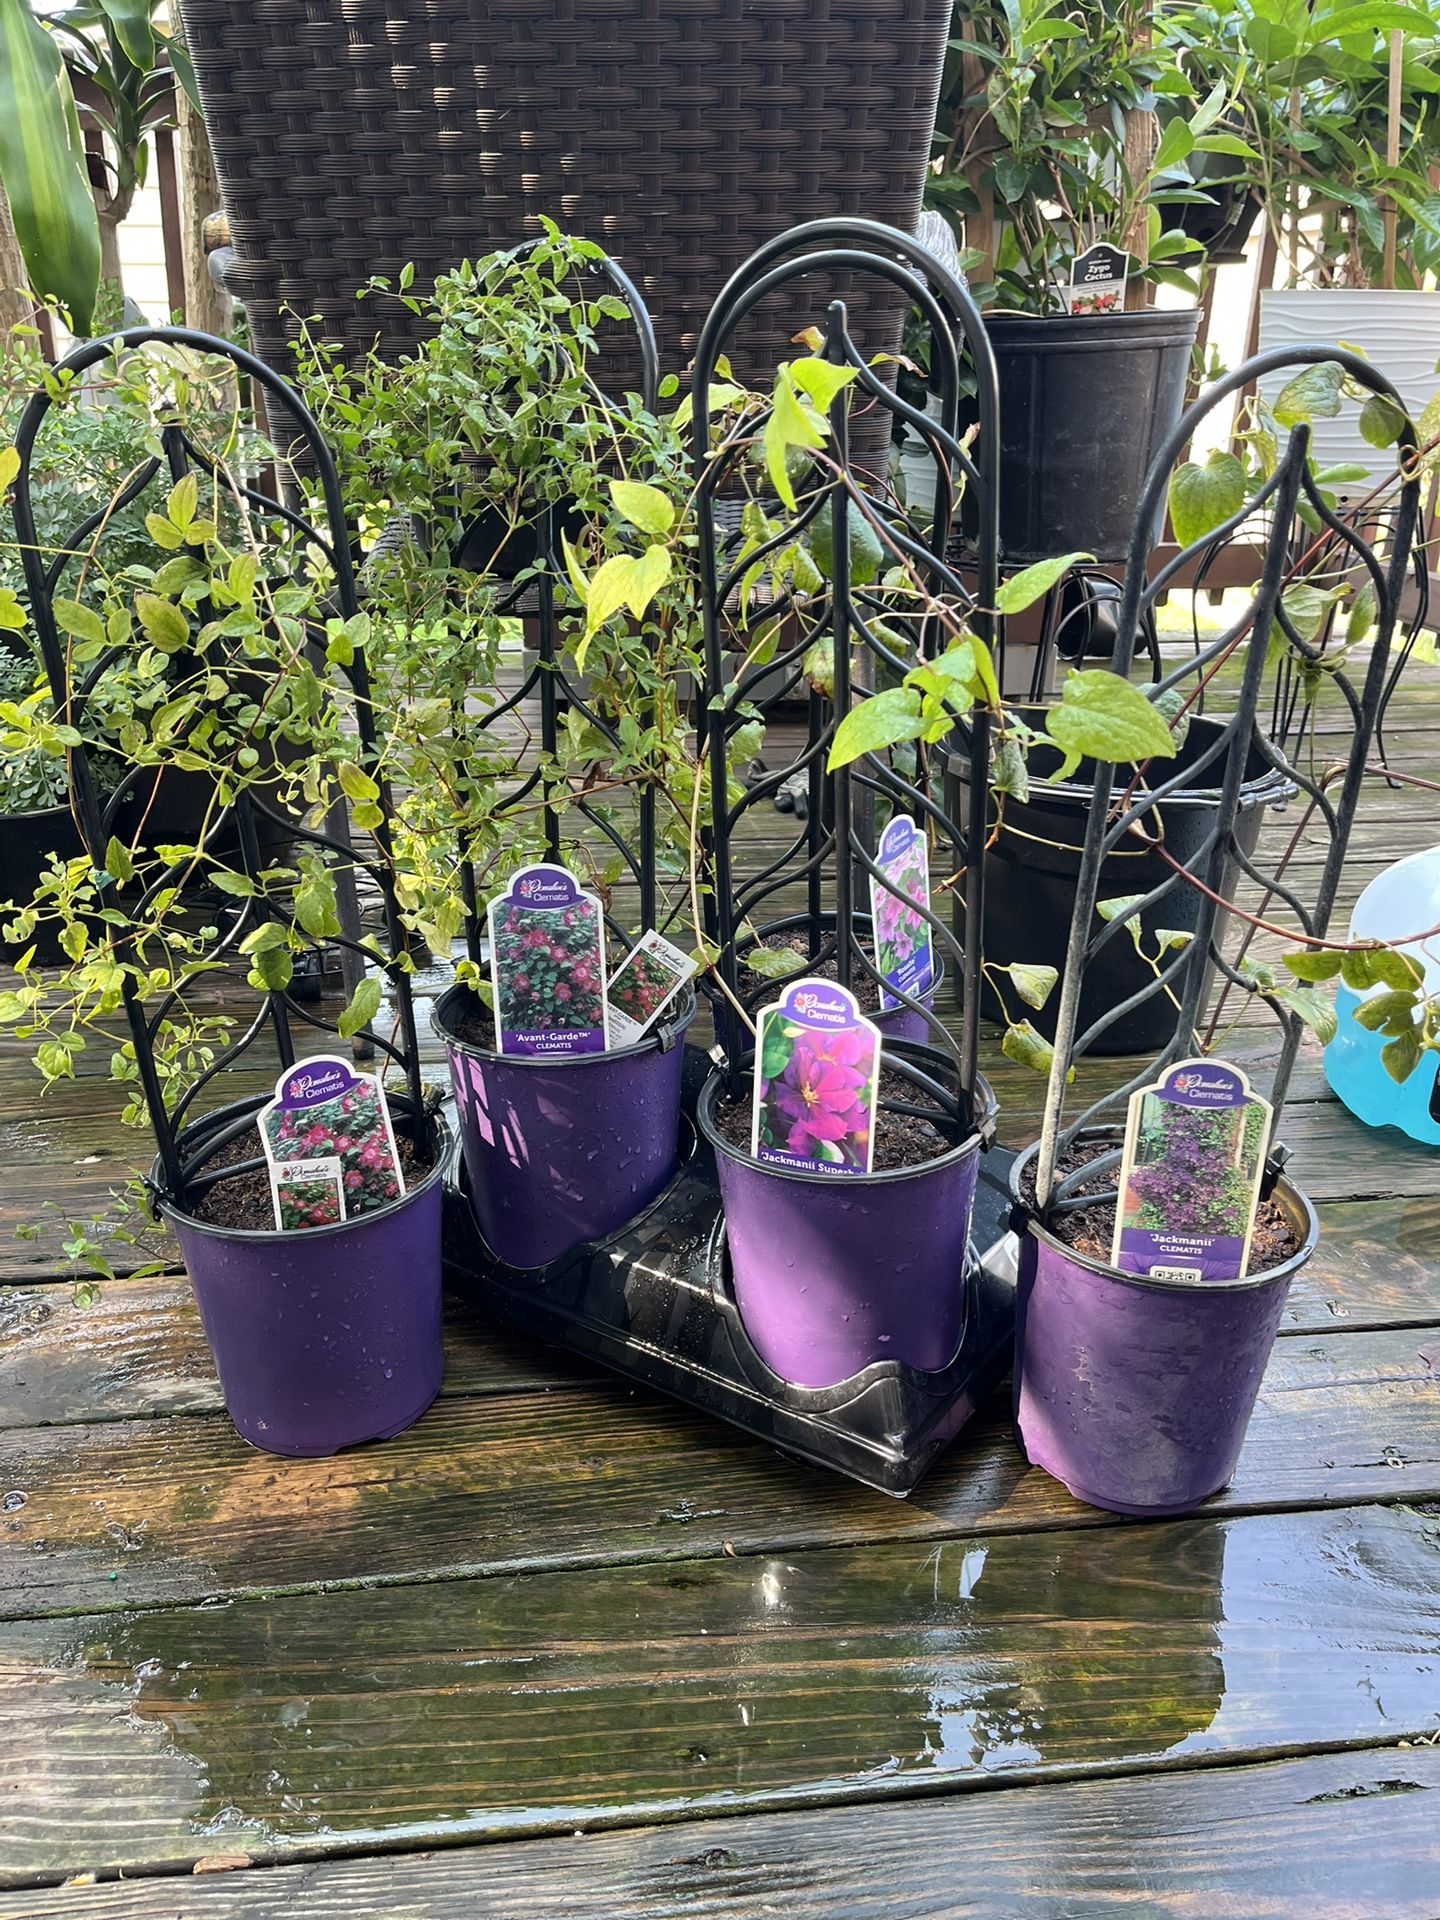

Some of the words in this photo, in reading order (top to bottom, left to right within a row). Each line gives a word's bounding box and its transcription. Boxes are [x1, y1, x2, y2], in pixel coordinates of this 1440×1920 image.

[1088, 264, 1111, 274] Zygo
[1084, 272, 1113, 282] Cactus
[533, 892, 570, 902] Clematis
[807, 1008, 847, 1025] Clematis
[535, 1042, 572, 1050] CLEMATIS
[305, 1081, 345, 1099] Clematis
[1189, 1089, 1234, 1101] Clematis
[761, 1151, 816, 1171] 'Jackmanii
[1150, 1233, 1216, 1247] 'Jackmanii'
[1159, 1245, 1203, 1255] CLEMATIS
